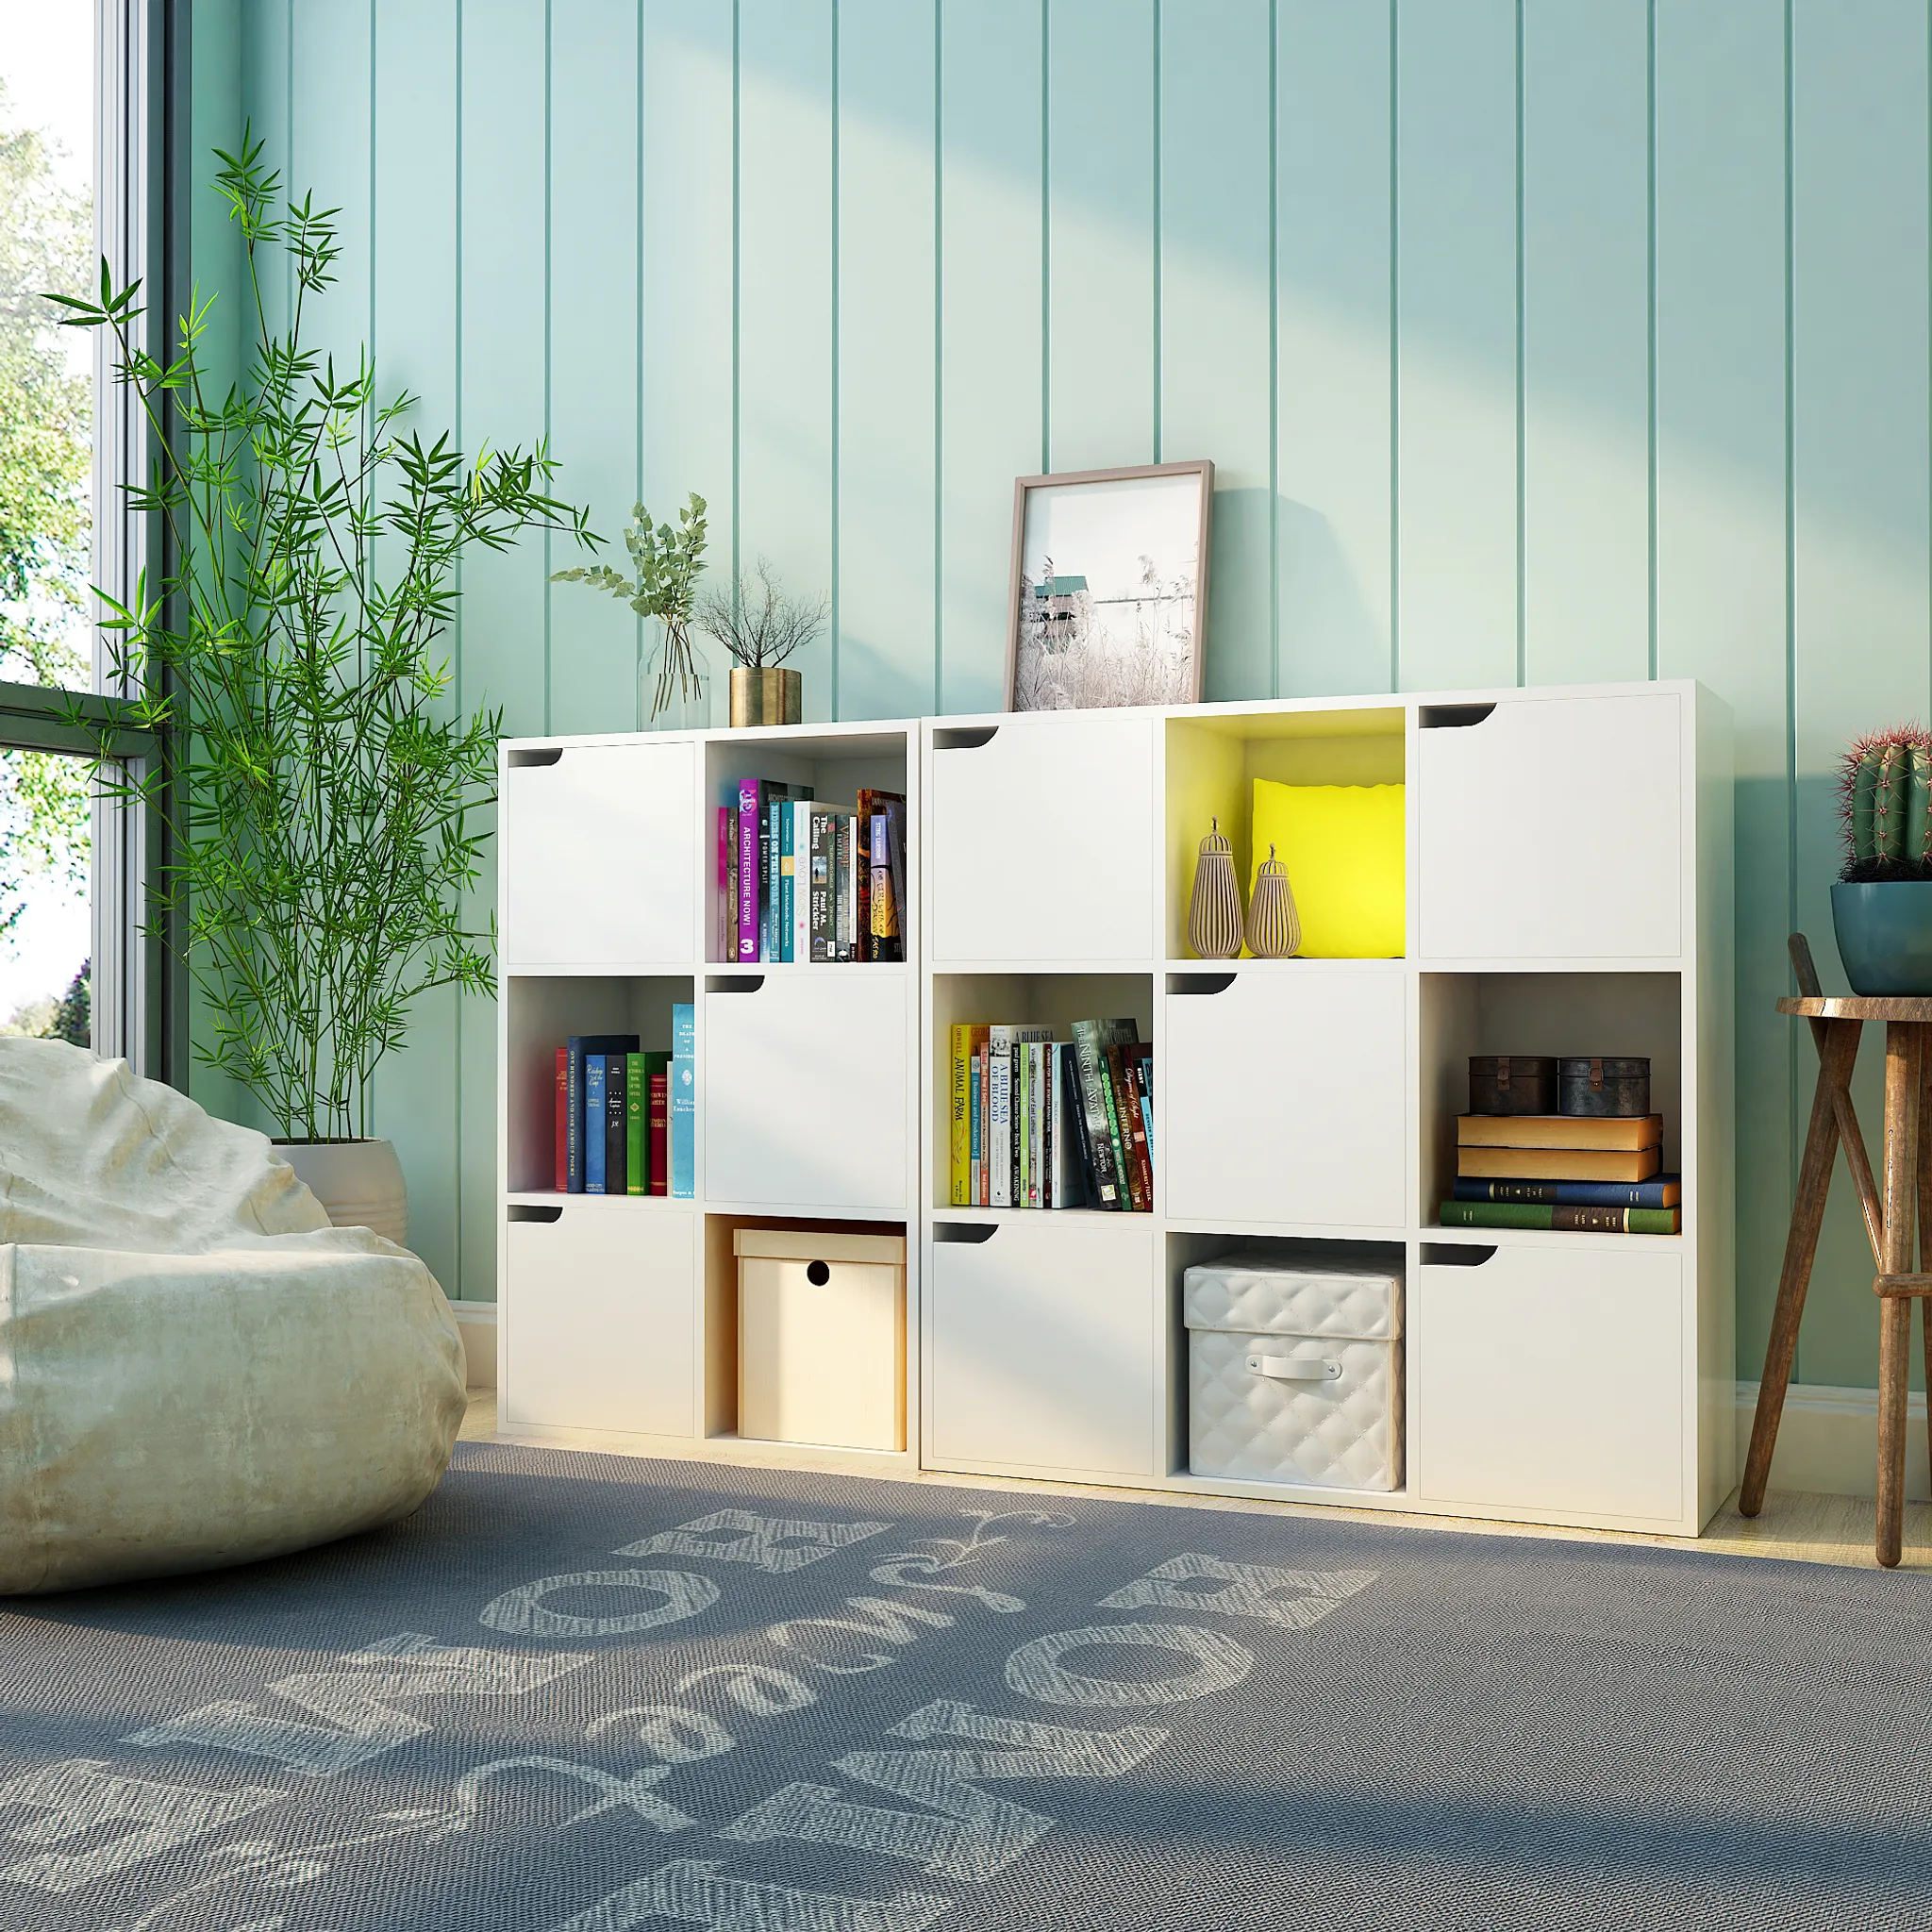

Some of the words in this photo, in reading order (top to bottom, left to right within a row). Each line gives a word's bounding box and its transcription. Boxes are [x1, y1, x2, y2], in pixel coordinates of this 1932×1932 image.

[771, 805, 779, 839] RIDERS
[811, 816, 820, 850] Calling
[771, 841, 779, 854] ON
[839, 824, 849, 868] VAMPIRE
[742, 826, 751, 897] ARCHITECTURE
[771, 855, 779, 874] THE
[796, 857, 808, 886] Love
[771, 874, 779, 906] STORM
[796, 889, 807, 916] Slow
[742, 900, 751, 926] NOW!
[820, 914, 827, 926] M.
[740, 939, 754, 955] 3
[955, 1057, 965, 1093] ANIMAL
[991, 1066, 999, 1080] OF
[1077, 1042, 1095, 1083] NINTH
[1000, 1074, 1008, 1103] BLUE
[955, 1096, 965, 1122] FARM
[1000, 1105, 1008, 1124] SEA
[1085, 1084, 1105, 1131] AVATAR
[1118, 1106, 1132, 1150] INFERNO
